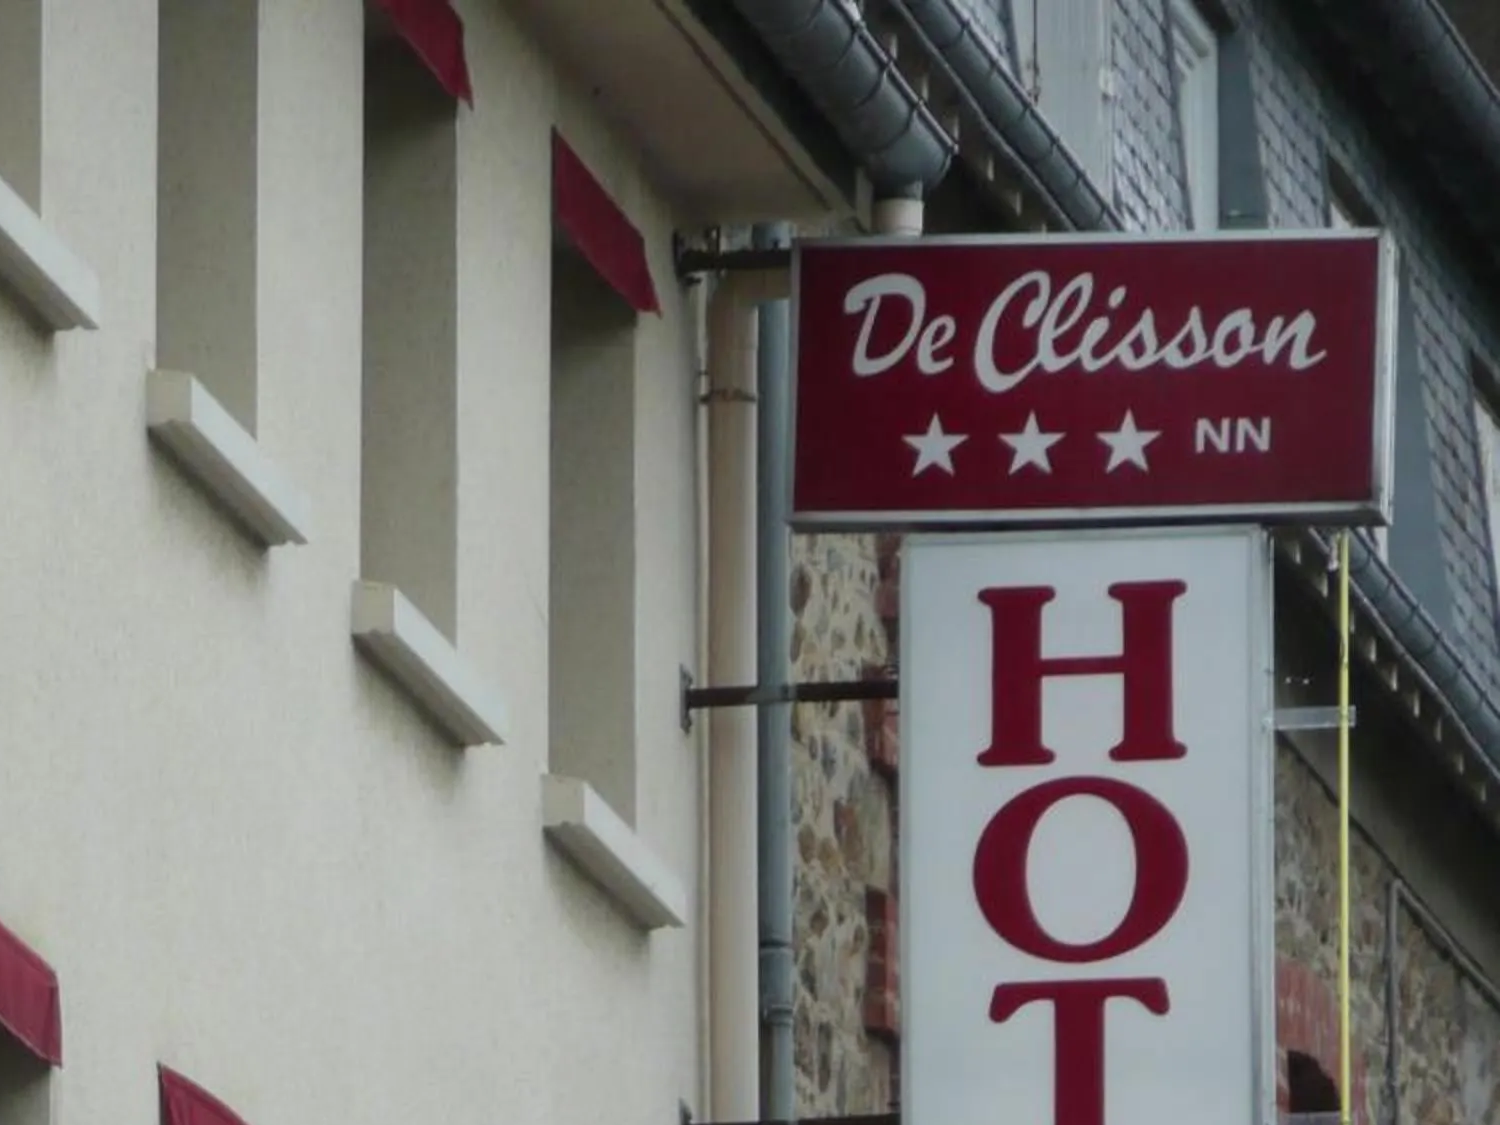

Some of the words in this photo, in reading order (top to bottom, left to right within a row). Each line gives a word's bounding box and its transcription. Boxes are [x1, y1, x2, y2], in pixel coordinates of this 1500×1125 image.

[844, 273, 956, 377] De
[974, 270, 1328, 393] Clisson
[1195, 417, 1272, 453] NN
